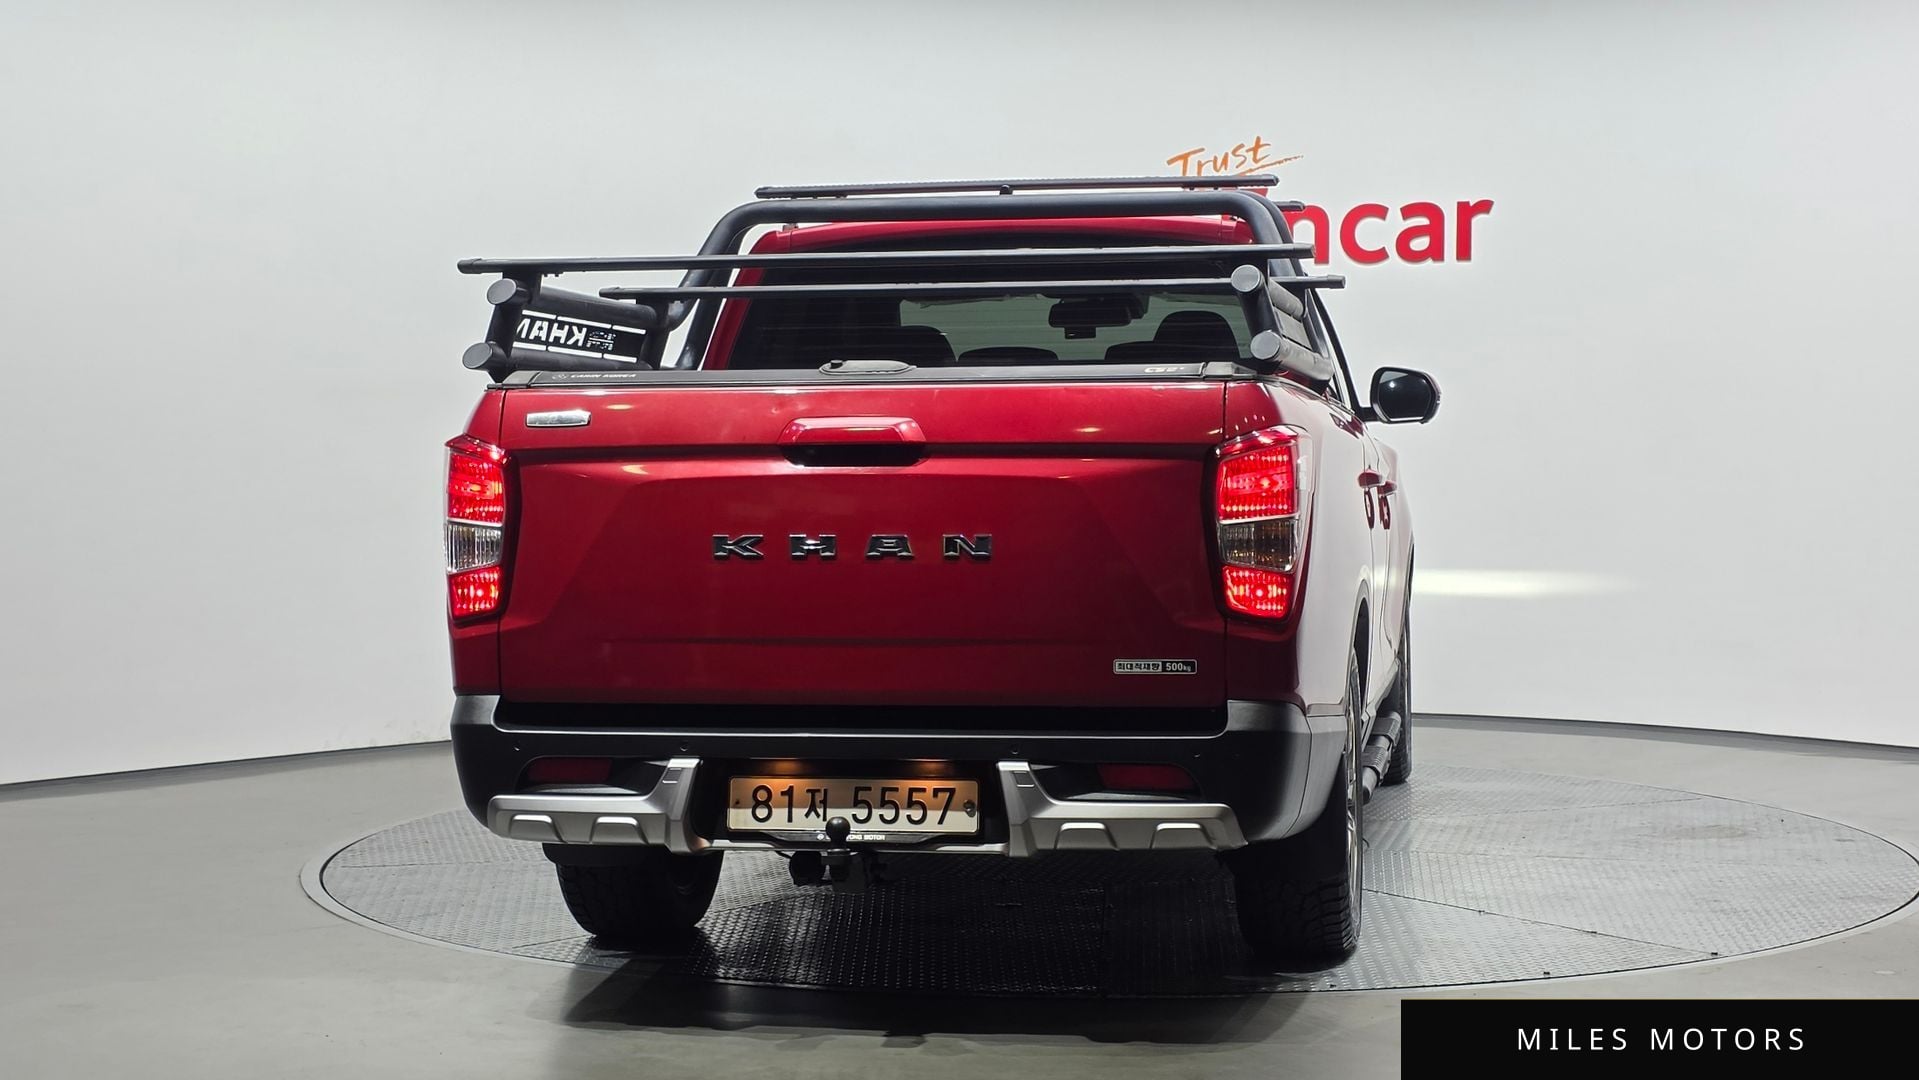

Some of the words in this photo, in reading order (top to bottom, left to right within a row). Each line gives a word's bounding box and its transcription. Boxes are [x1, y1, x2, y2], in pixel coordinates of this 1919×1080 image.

[1166, 135, 1272, 176] Trust
[1240, 189, 1495, 264] ncar
[712, 533, 993, 558] KHAN
[751, 784, 828, 823] 81저
[851, 786, 957, 825] 5557
